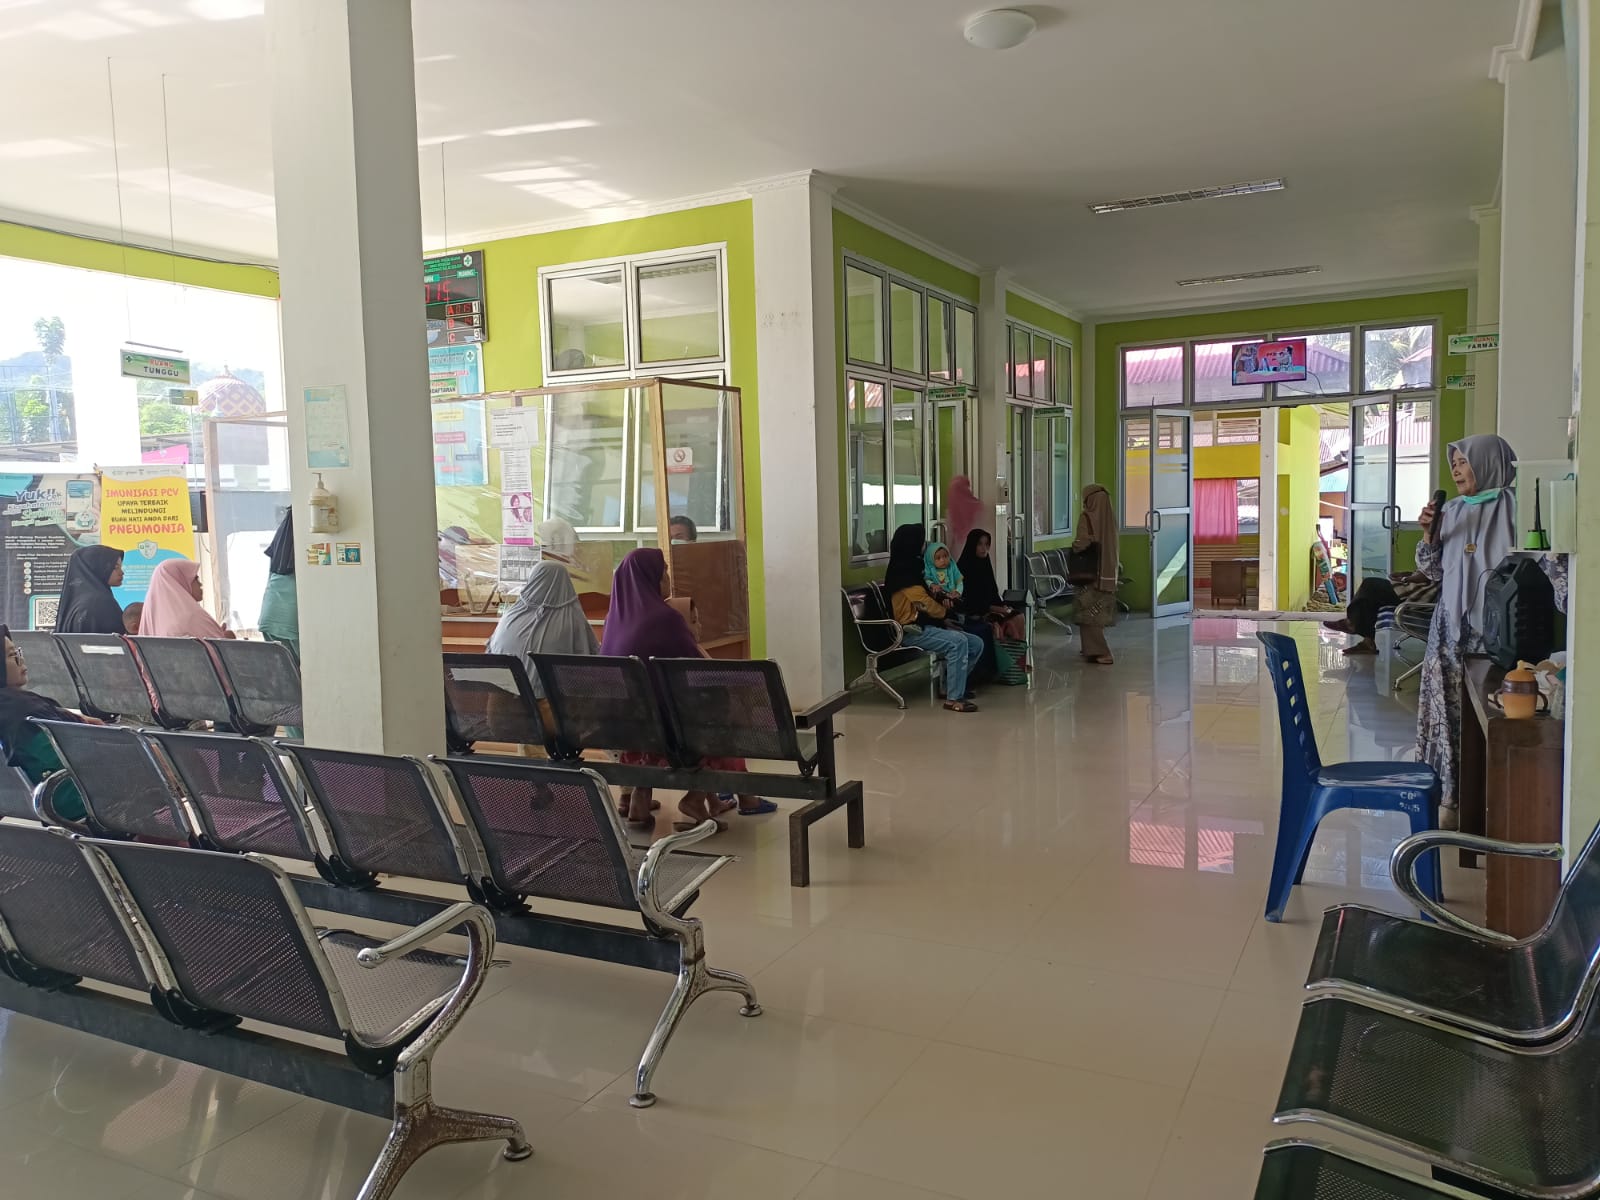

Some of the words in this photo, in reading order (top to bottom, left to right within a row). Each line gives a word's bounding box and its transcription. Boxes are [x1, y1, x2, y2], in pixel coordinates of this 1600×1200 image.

[143, 366, 179, 377] TUNGGU
[106, 488, 157, 498] IMUNISASI
[160, 488, 179, 497] PCV
[121, 507, 166, 515] MELINDUNGI
[108, 523, 185, 535] PNEUMONIA
